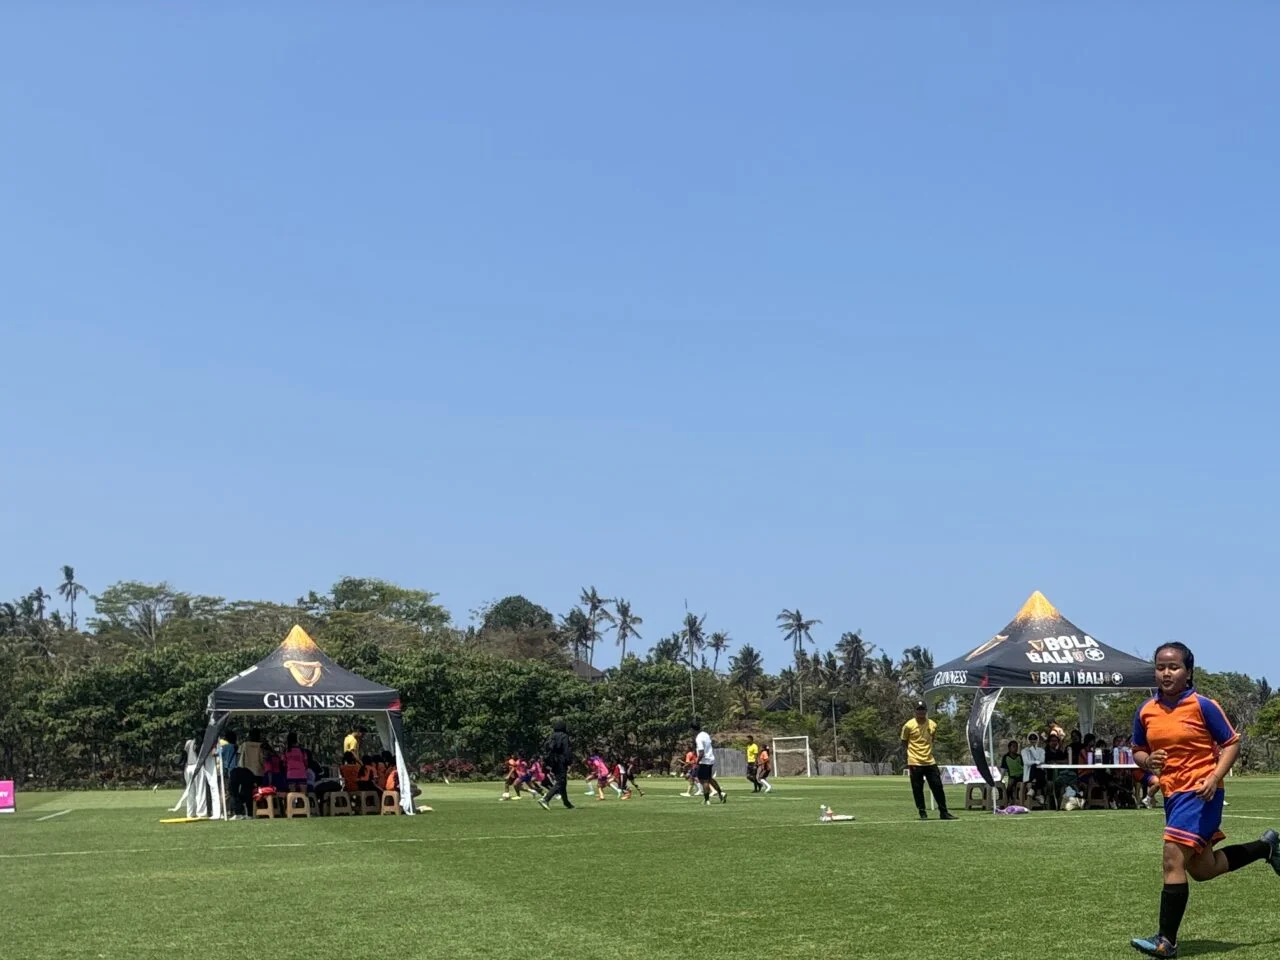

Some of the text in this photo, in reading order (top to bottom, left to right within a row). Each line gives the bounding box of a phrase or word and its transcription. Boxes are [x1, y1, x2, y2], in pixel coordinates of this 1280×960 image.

[1043, 635, 1099, 651] BOLA
[1026, 651, 1074, 663] BALI
[1040, 671, 1104, 685] BOLA BALI
[263, 692, 355, 708] GUINNESS
